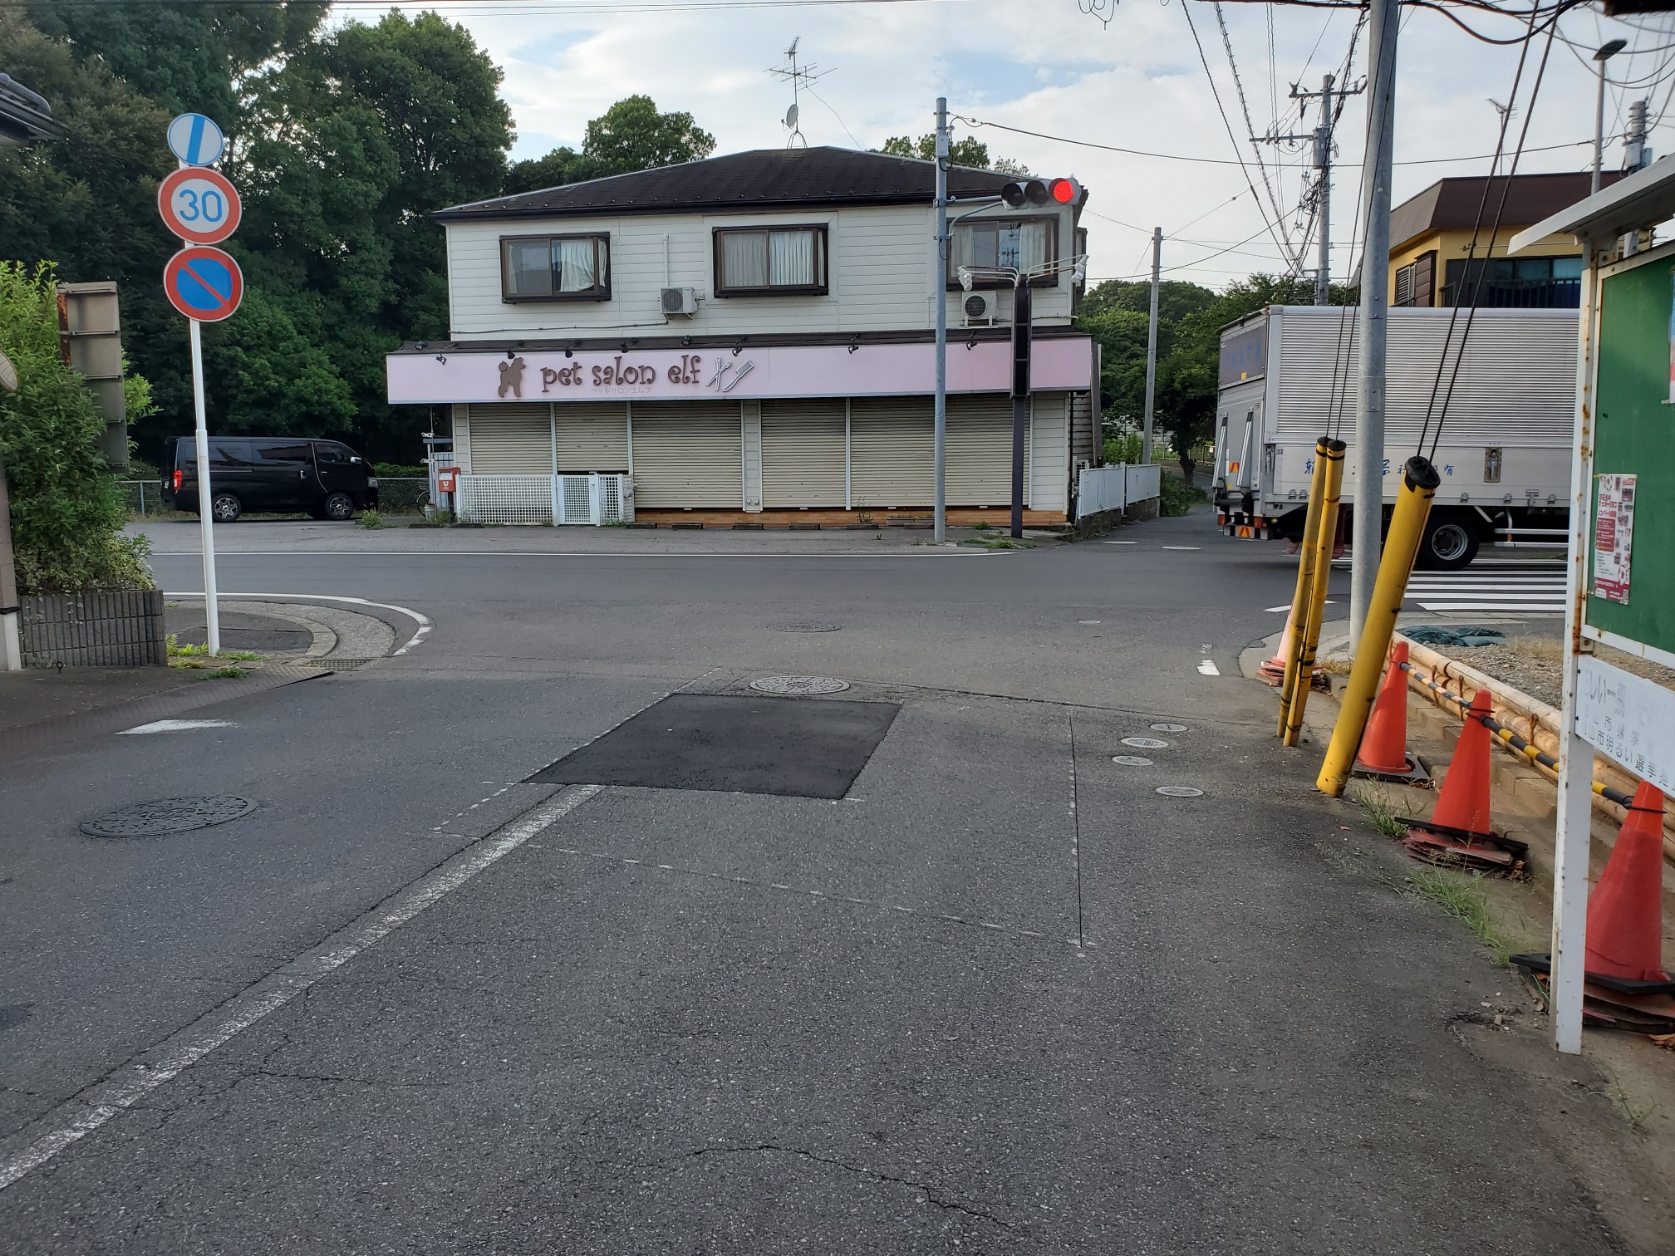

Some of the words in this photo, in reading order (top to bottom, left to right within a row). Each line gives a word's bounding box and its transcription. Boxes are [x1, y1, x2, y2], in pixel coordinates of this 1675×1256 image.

[179, 189, 223, 223] 30
[540, 361, 583, 392] pet
[591, 355, 656, 387] salon
[667, 354, 702, 385] elf
[591, 386, 652, 394] ペットサロンエルフ
